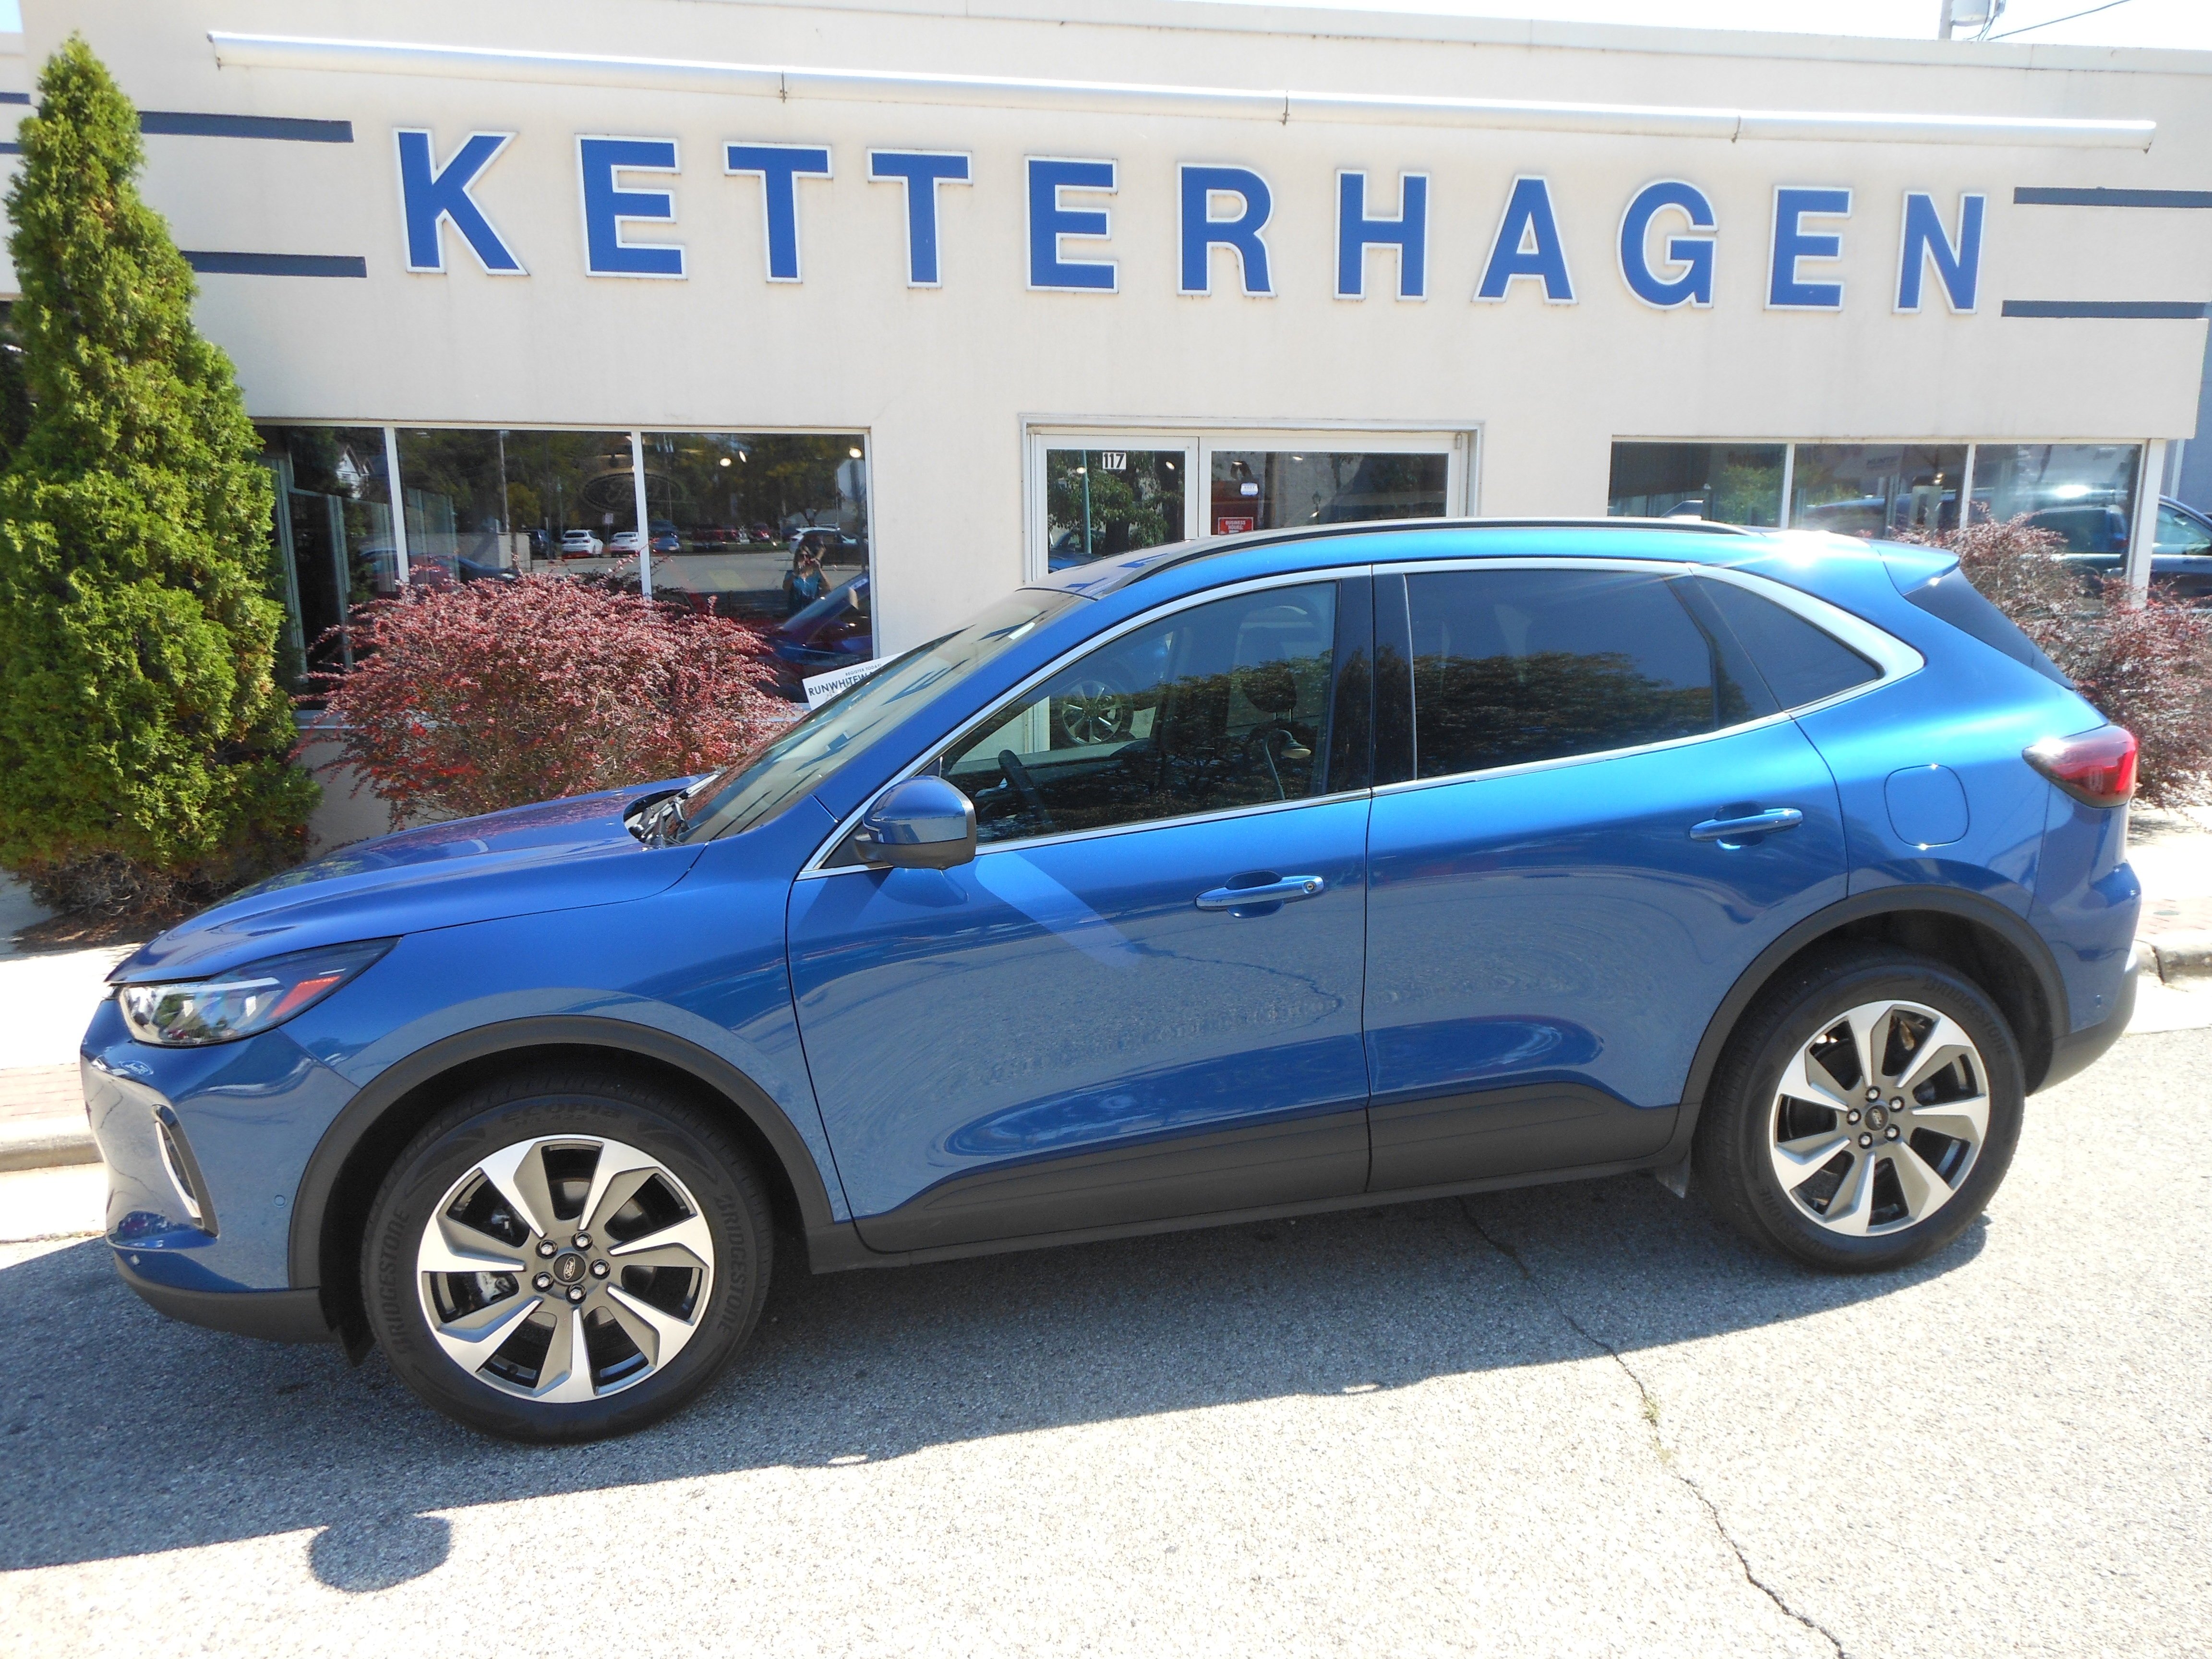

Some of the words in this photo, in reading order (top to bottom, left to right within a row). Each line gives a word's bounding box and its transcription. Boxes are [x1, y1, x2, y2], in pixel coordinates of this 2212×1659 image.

[394, 127, 1987, 314] KETTERHAGEN
[1104, 453, 1124, 468] 117
[845, 668, 864, 676] REGISTER
